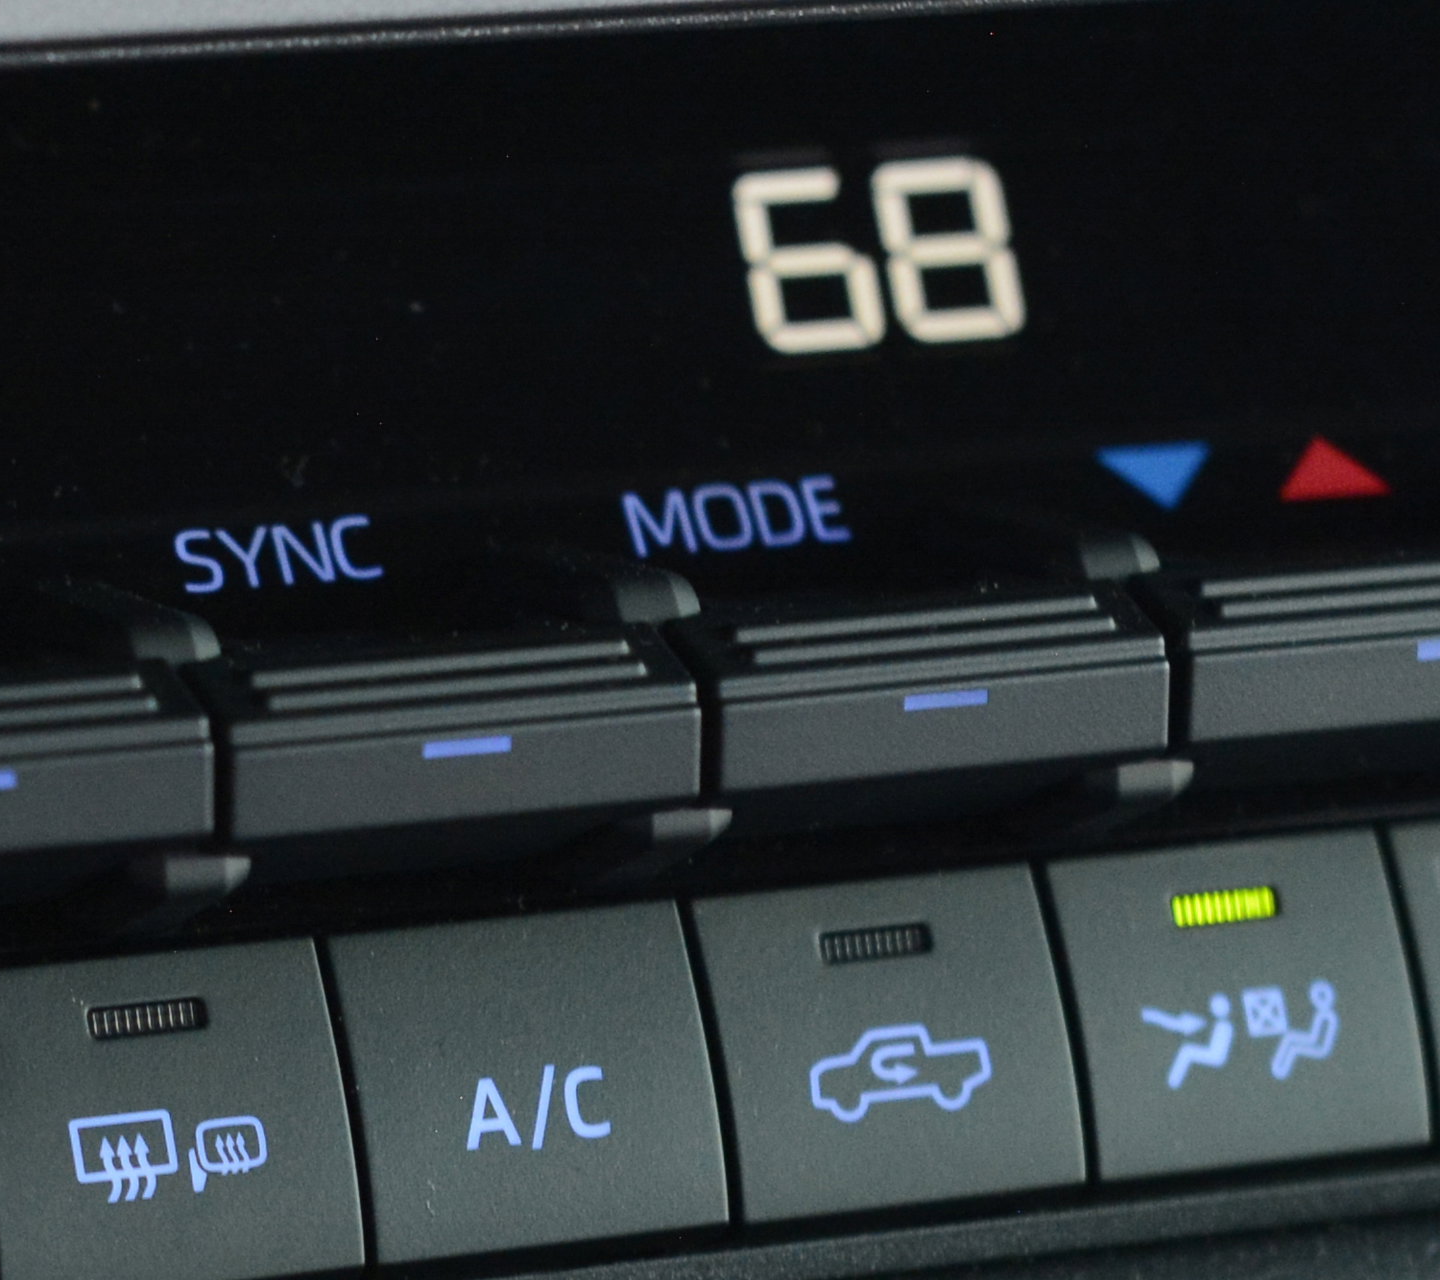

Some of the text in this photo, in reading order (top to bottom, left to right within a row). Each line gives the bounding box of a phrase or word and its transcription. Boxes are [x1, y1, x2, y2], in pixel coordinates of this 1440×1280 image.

[731, 155, 1027, 356] 68
[172, 514, 385, 595] SYNC
[620, 475, 852, 558] MODE
[465, 1062, 613, 1152] A/C
